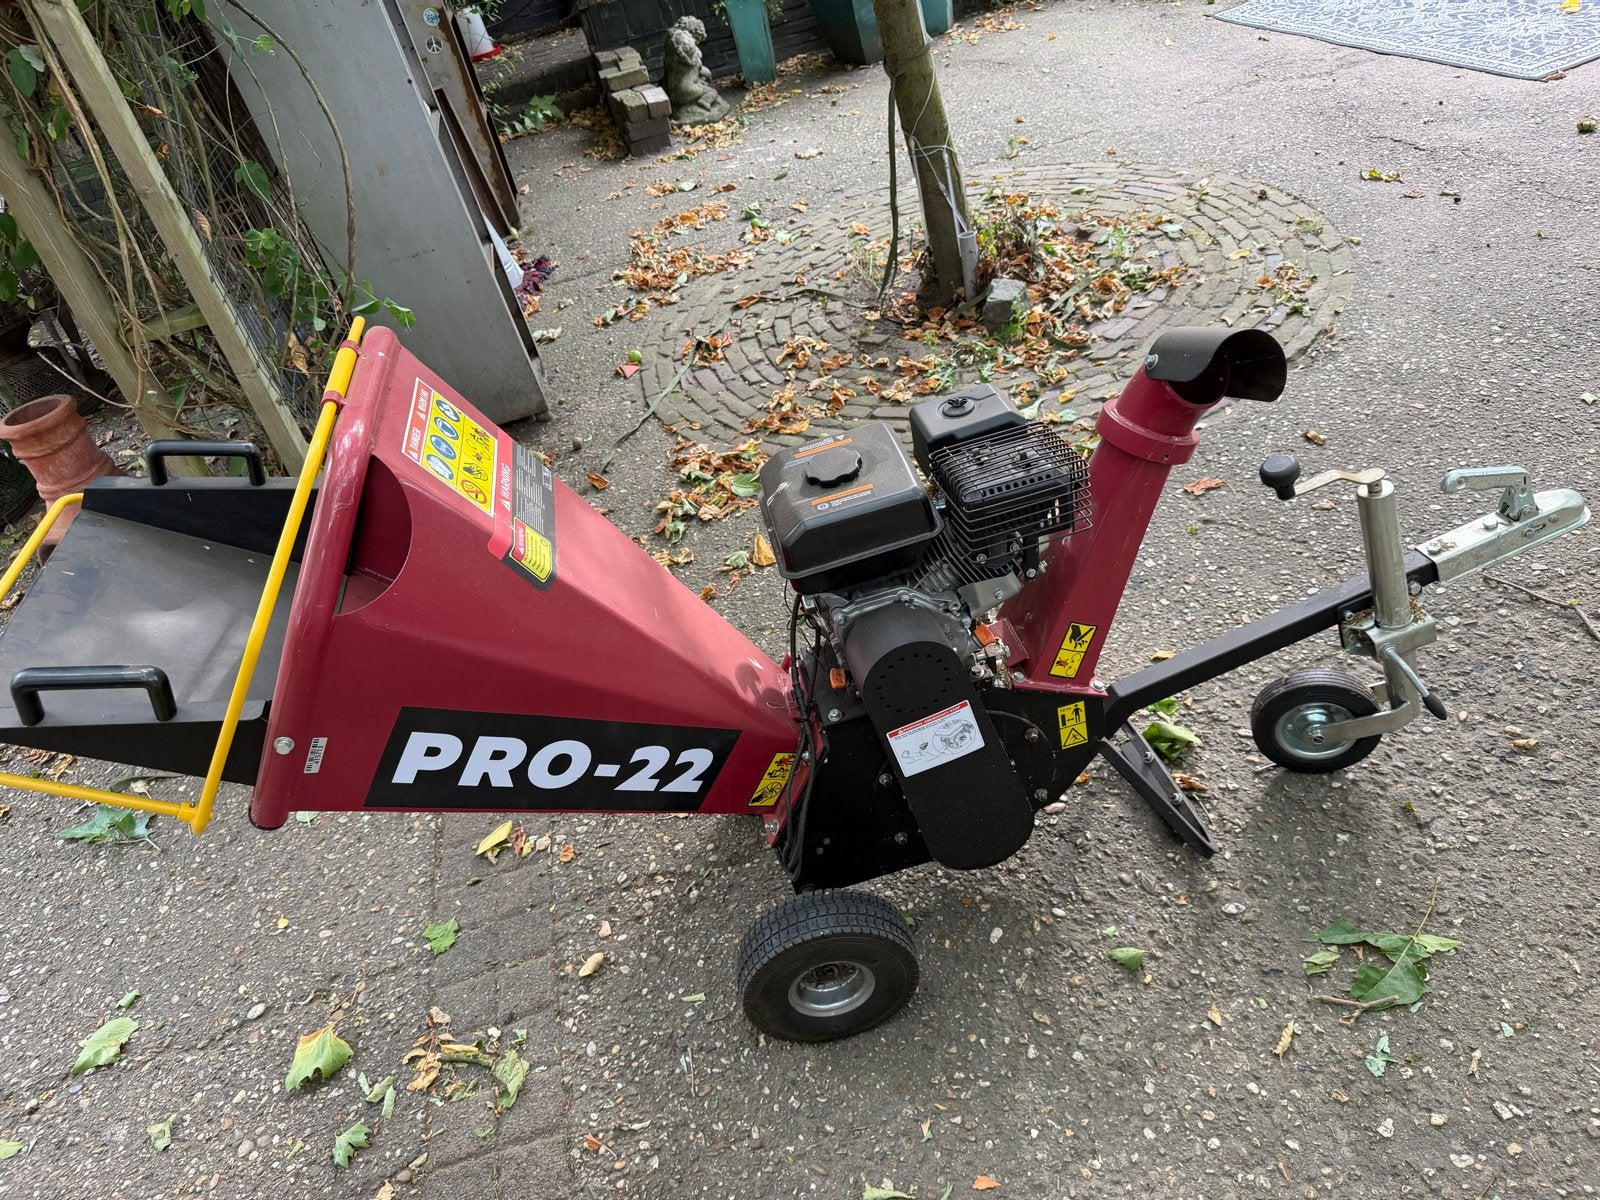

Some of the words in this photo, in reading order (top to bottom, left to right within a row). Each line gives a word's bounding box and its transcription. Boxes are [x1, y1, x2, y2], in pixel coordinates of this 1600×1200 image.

[409, 427, 421, 451] DANGER
[417, 388, 429, 412] WARNING
[500, 463, 511, 499] WARNING
[313, 746, 324, 764] 415713
[392, 732, 713, 792] PRO-22
